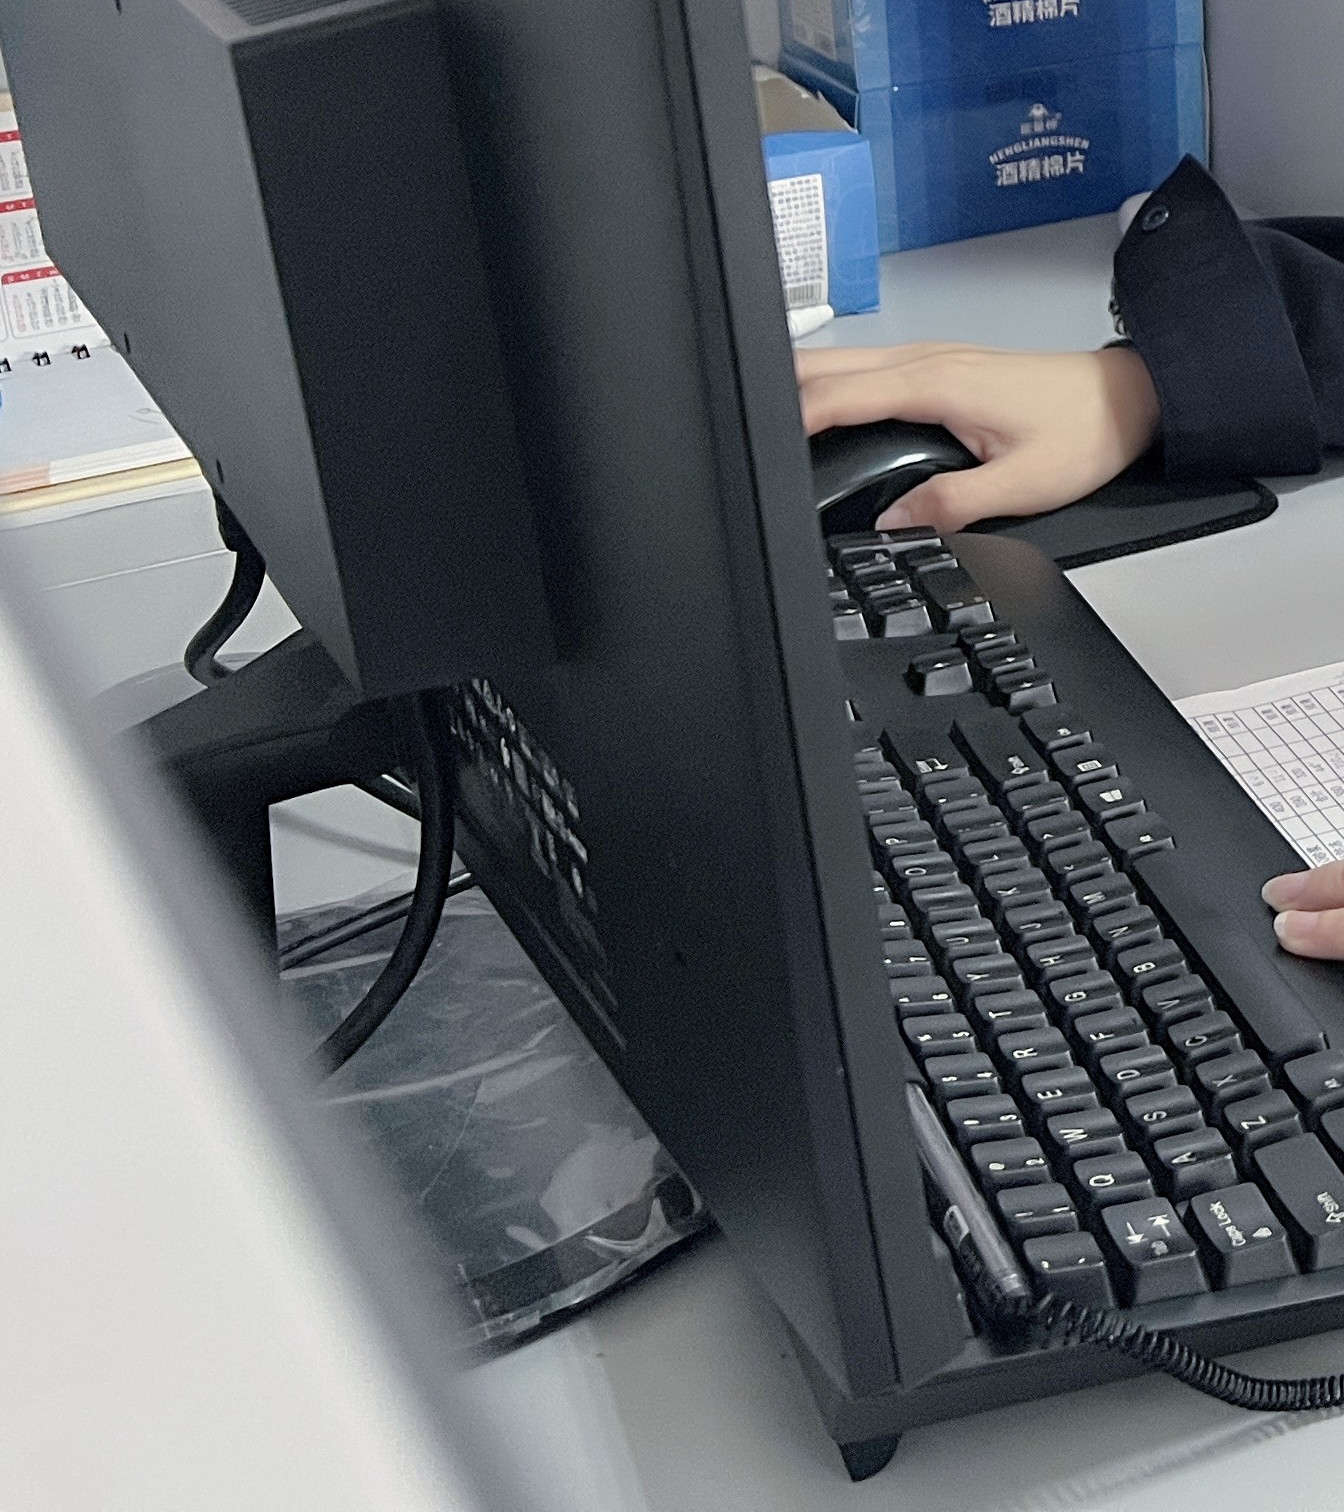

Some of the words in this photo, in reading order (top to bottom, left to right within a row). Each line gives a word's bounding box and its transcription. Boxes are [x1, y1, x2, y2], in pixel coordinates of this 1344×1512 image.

[996, 150, 1086, 186] 酒精棉片
[1039, 954, 1065, 967] H
[1133, 961, 1157, 974] B
[1064, 991, 1087, 1002] G
[988, 1009, 1013, 1019] T
[1089, 1031, 1114, 1041] F
[1185, 1035, 1208, 1047] C
[1013, 1047, 1038, 1059] R
[1116, 1068, 1141, 1080] D
[1212, 1074, 1238, 1088] X
[1037, 1088, 1063, 1100] E
[1143, 1110, 1167, 1122] S
[1240, 1115, 1267, 1130] Z
[1058, 1127, 1088, 1143] W
[1171, 1151, 1197, 1164] A
[1088, 1173, 1115, 1187] Q
[1209, 1200, 1232, 1227] Lock
